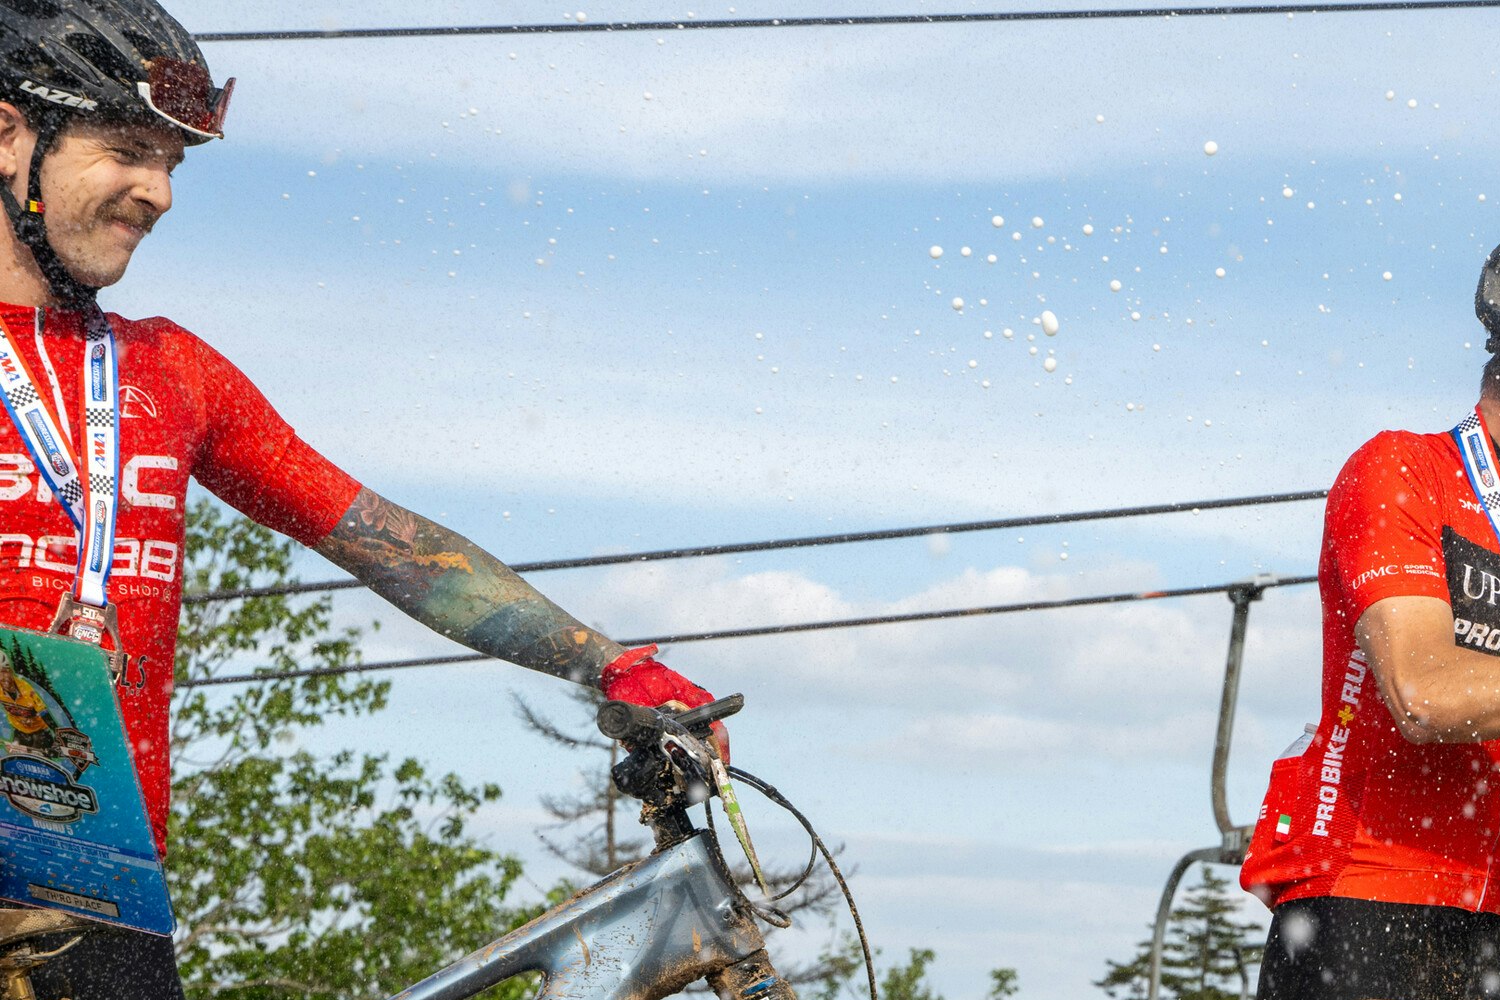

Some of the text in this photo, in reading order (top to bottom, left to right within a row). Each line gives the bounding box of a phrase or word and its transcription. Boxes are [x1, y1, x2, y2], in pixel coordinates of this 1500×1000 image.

[19, 80, 98, 111] LAZER
[93, 432, 106, 468] AMA
[1352, 565, 1399, 590] UPMC
[0, 776, 92, 809] nowshoe
[45, 890, 102, 910] THIRD PLACE
